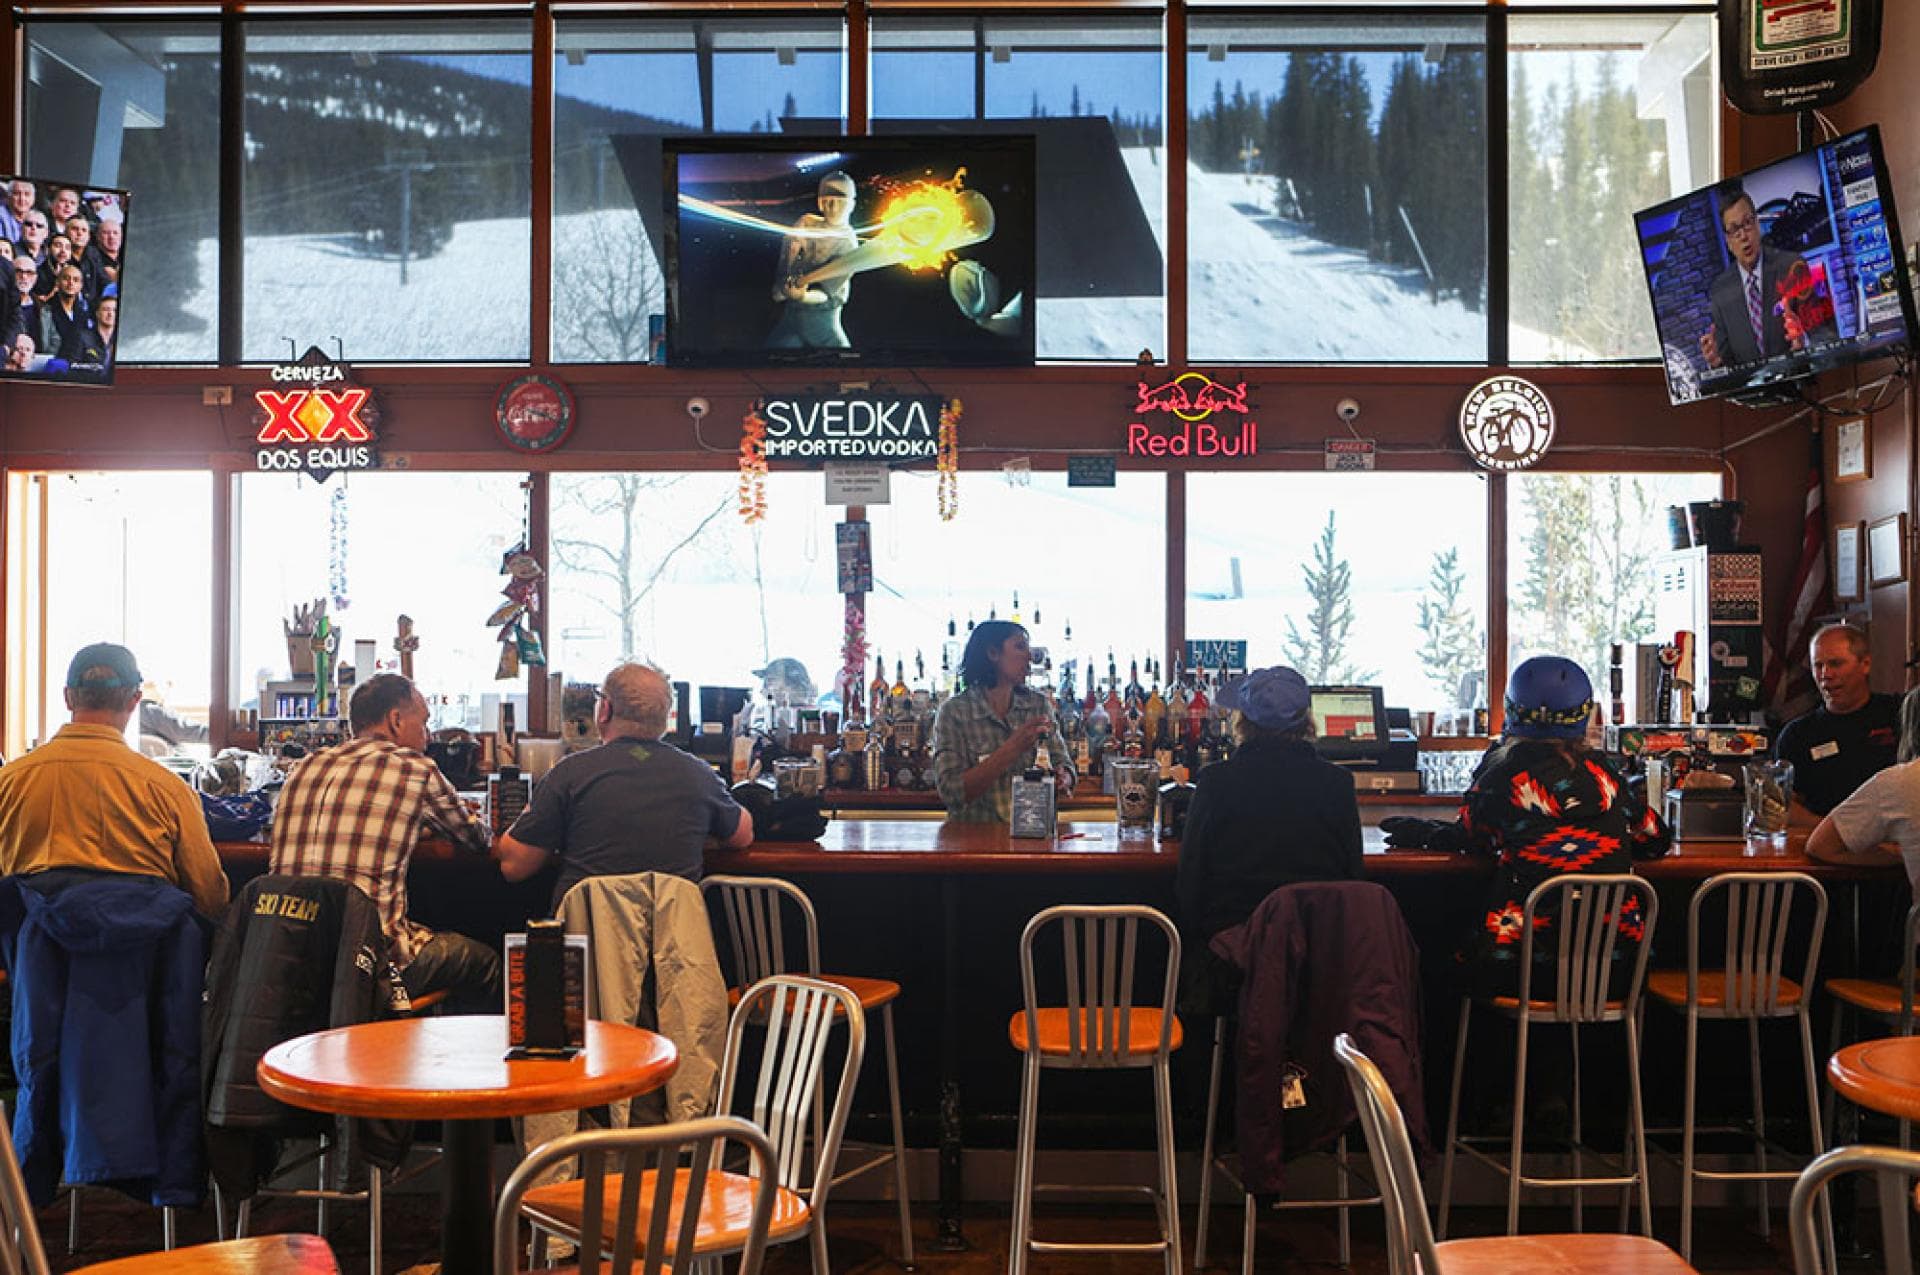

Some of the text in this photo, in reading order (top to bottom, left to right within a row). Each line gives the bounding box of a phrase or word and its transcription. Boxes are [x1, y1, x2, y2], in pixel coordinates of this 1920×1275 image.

[271, 366, 344, 381] CERVEZA
[255, 388, 371, 442] XX
[766, 400, 932, 437] SVEDKA
[765, 439, 938, 456] IMPORTED VODKA
[1128, 422, 1257, 456] Red Bull
[257, 446, 369, 469] DOS EQUIS
[1192, 640, 1238, 654] LIVE
[256, 893, 320, 922] SKI TEAM
